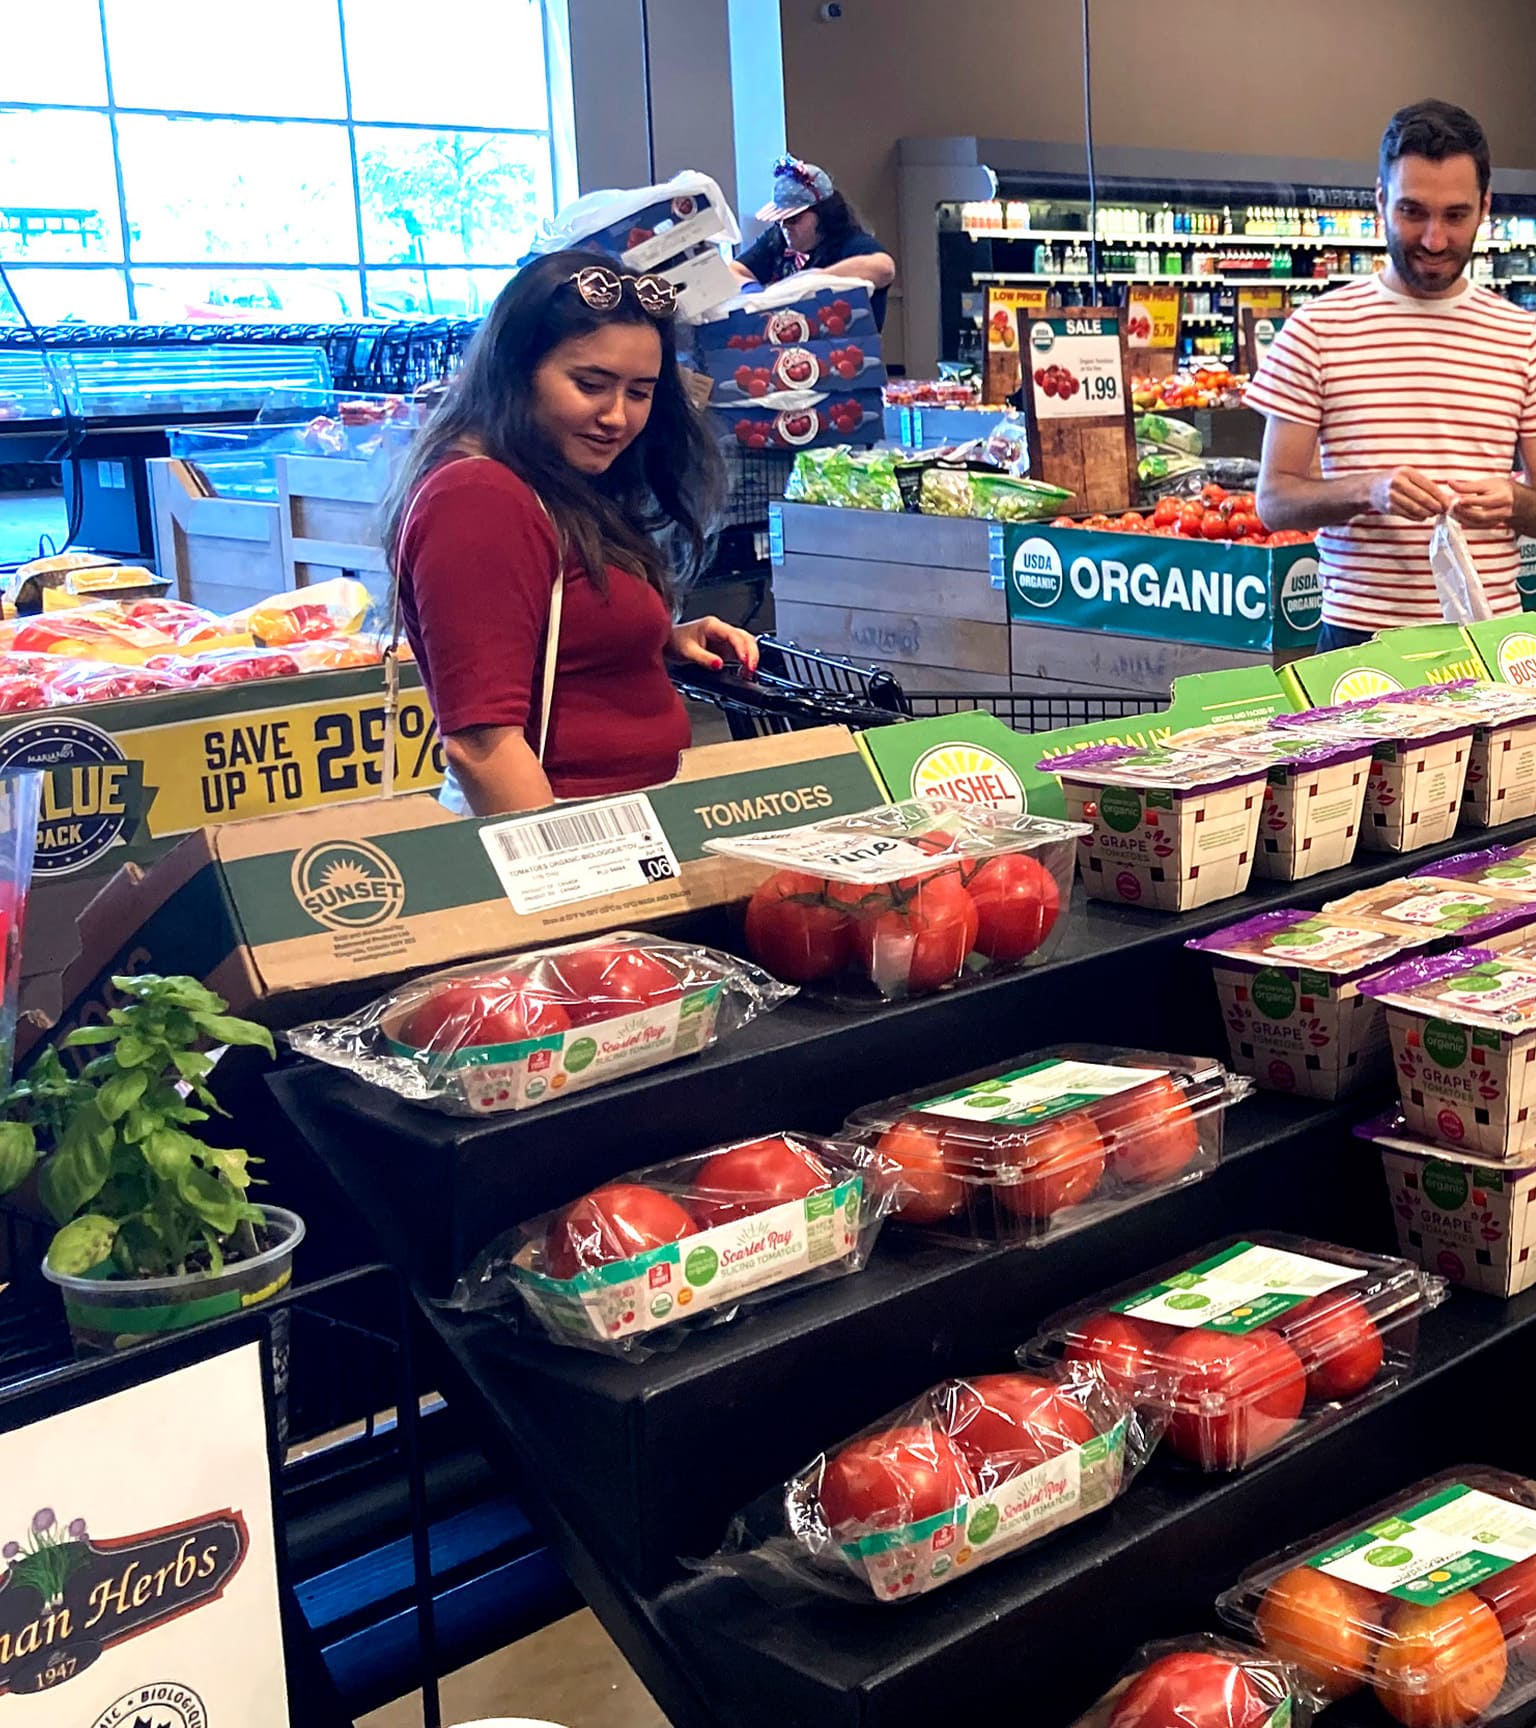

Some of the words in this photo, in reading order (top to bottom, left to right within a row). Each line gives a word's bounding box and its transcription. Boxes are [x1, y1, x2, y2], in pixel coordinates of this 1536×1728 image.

[1066, 319, 1102, 335] SALE
[1081, 376, 1117, 401] 1.99
[1022, 555, 1055, 573] USDA
[1018, 574, 1058, 593] ORGANIC
[1070, 557, 1267, 620] ORGANIC
[1291, 574, 1318, 592] USDA
[1425, 658, 1484, 687] NATUR
[204, 722, 293, 771] SAVE
[201, 770, 247, 814] UP
[258, 763, 303, 804] TO
[694, 785, 833, 831] TOMATOES
[1102, 803, 1140, 819] organic
[1100, 834, 1147, 852] GRAPE
[304, 881, 403, 915] SUNSET
[1252, 1021, 1303, 1041] GRAPE
[1423, 1068, 1472, 1092] GRAPE
[1420, 1209, 1472, 1233] GRAPE
[719, 1237, 765, 1268] Scarlet
[767, 1228, 794, 1251] Ray
[84, 1537, 219, 1631] Herbs
[35, 1657, 78, 1690] 1947
[141, 1687, 204, 1728] BIOLOGIQU
